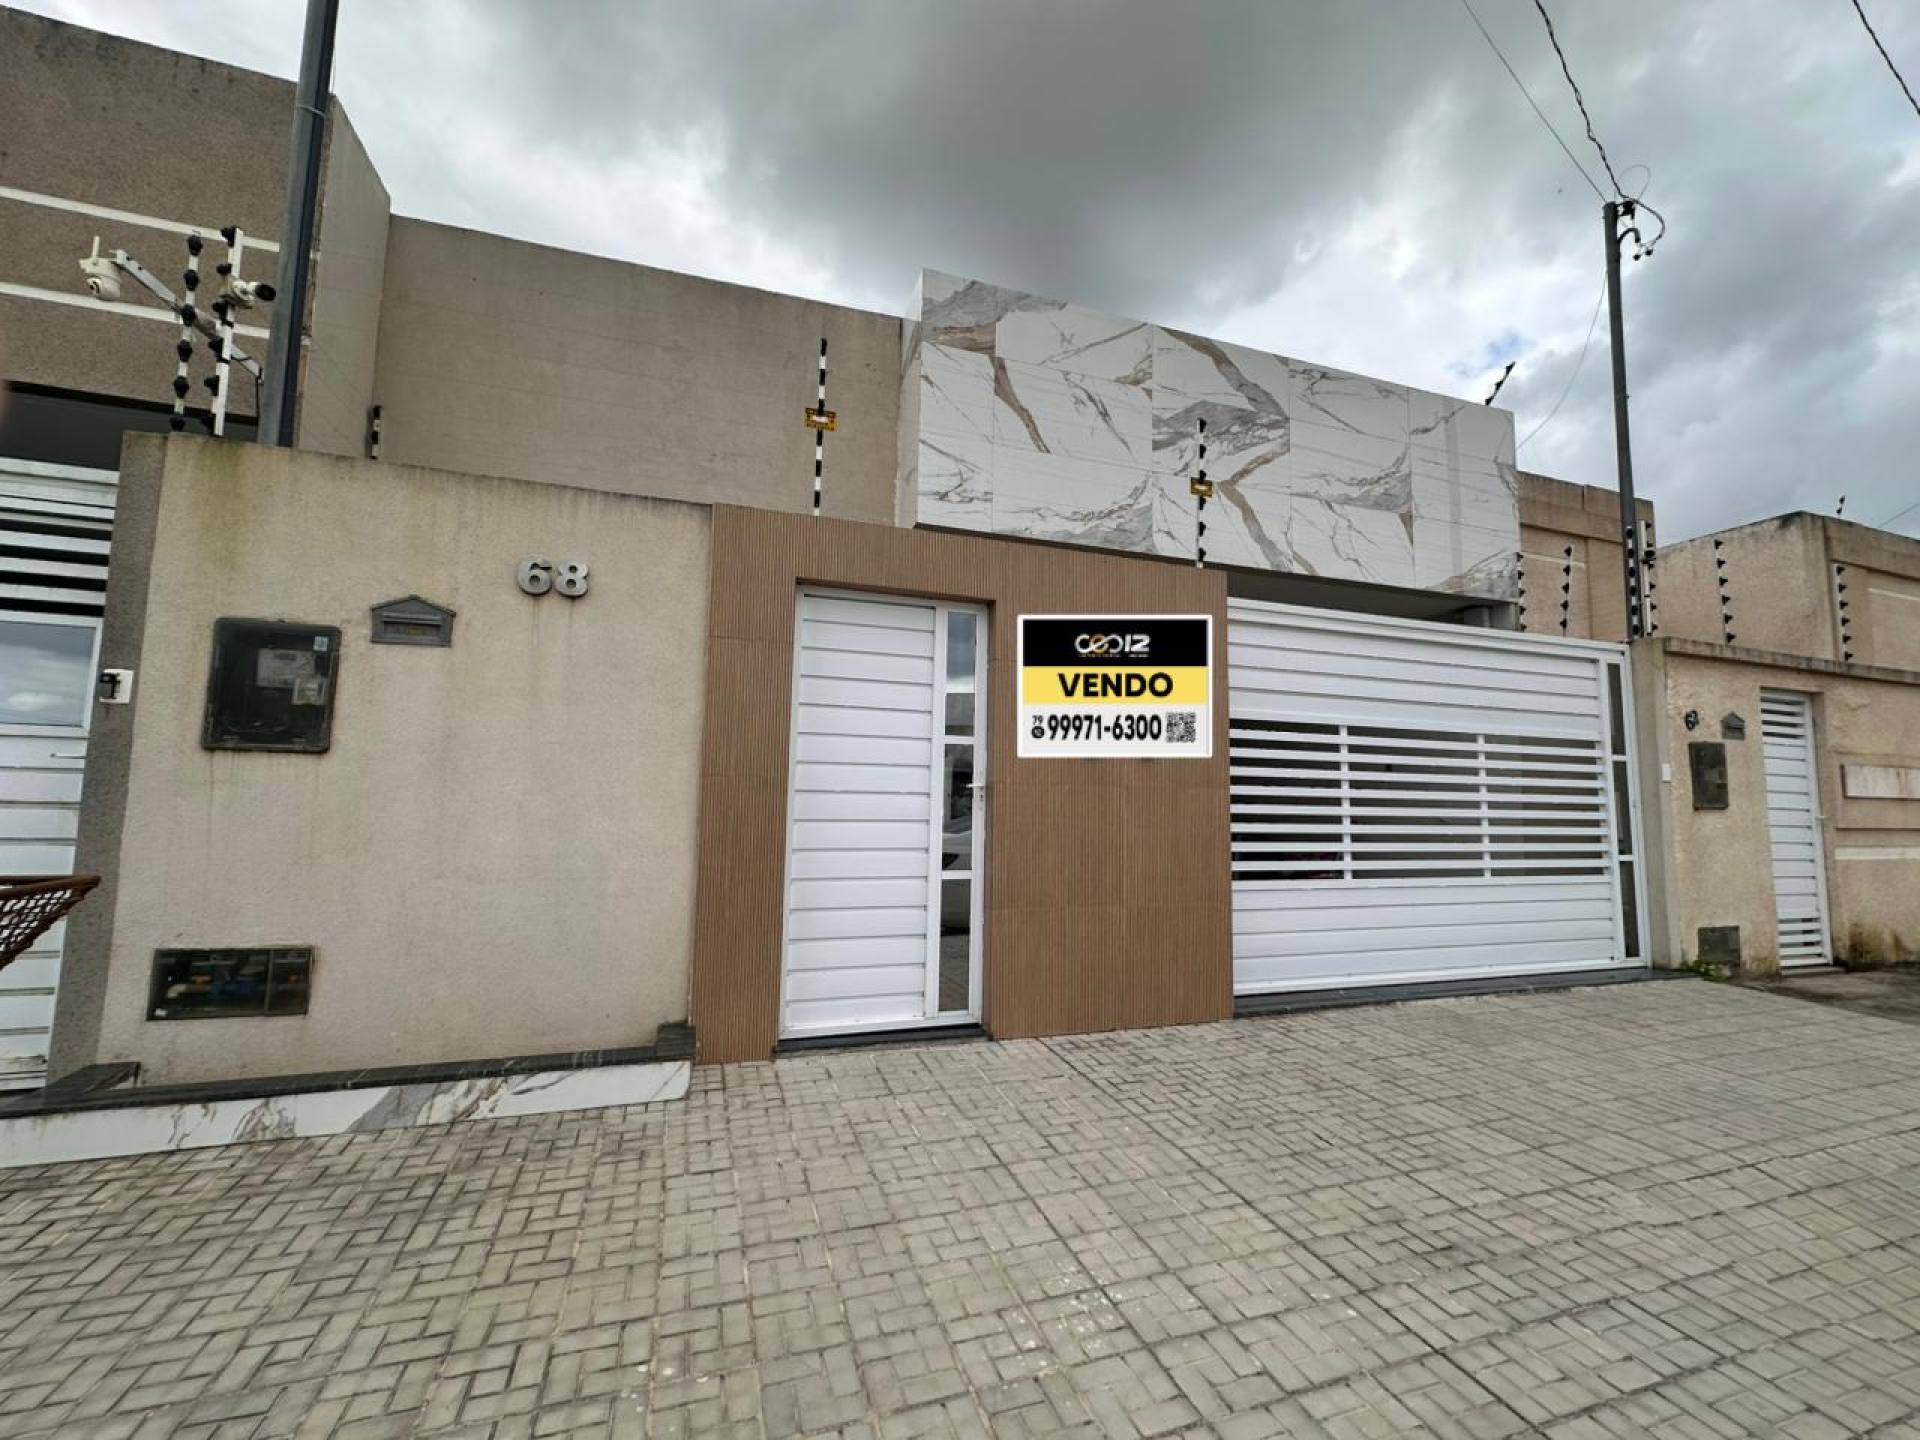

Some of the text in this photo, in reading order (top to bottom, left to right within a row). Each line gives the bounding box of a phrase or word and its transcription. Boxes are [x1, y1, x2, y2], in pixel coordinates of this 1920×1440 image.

[516, 556, 590, 597] 68
[1057, 672, 1174, 698] VENDO
[1047, 713, 1162, 741] 99971-6300
